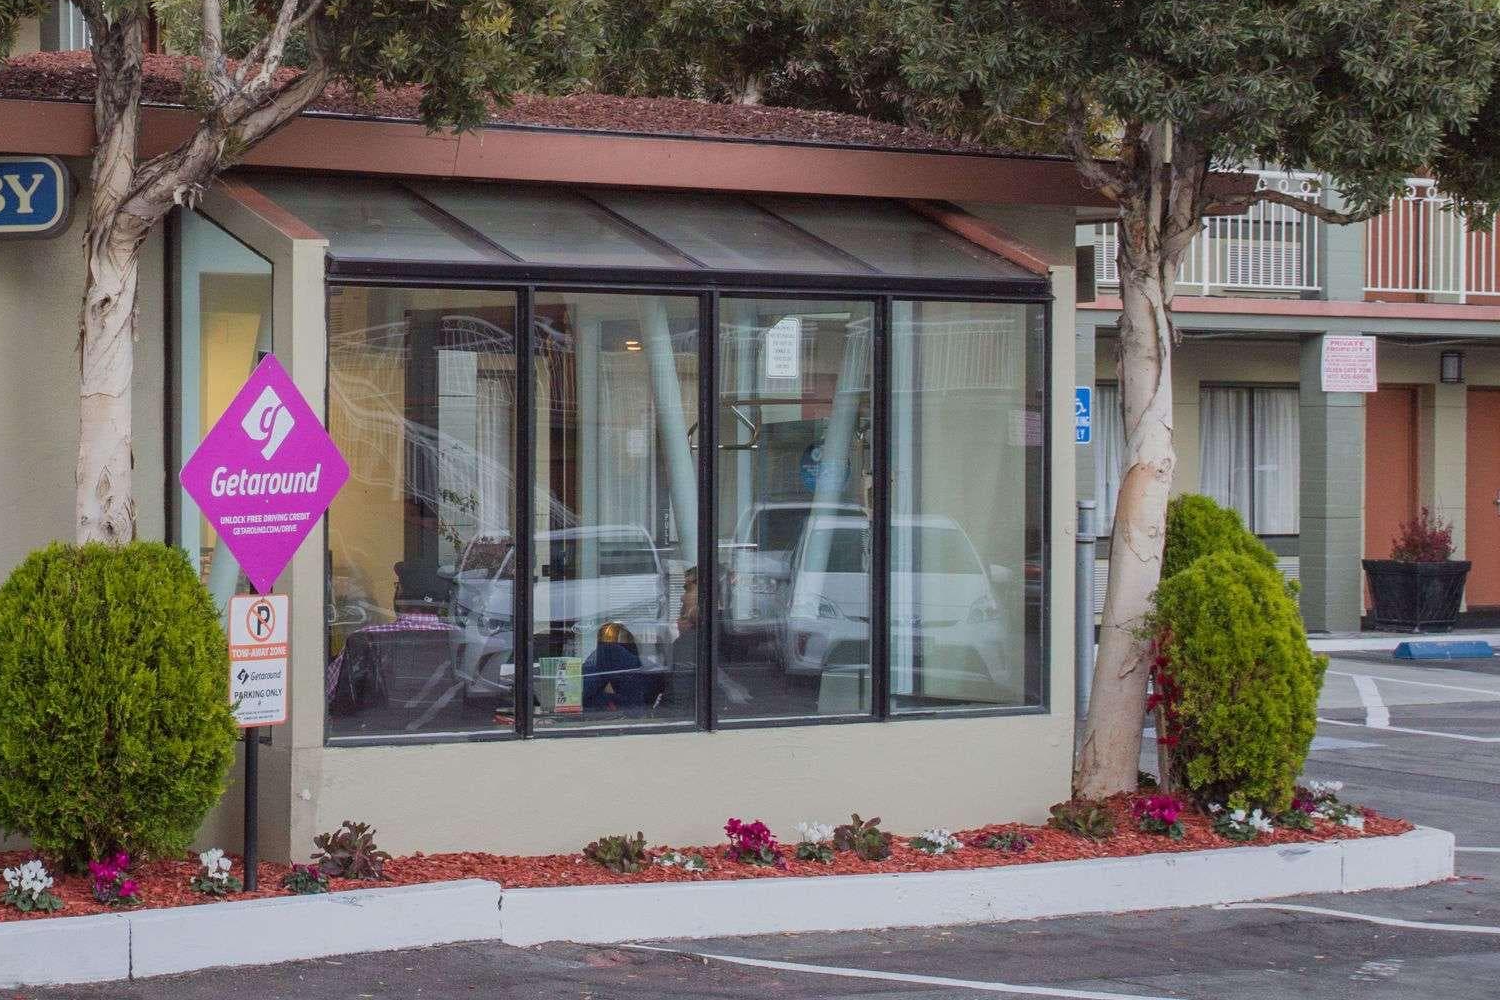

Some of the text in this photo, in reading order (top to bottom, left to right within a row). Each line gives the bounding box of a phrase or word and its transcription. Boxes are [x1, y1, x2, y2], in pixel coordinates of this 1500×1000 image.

[211, 463, 322, 497] Getaround
[220, 512, 310, 524] UNLOCK FREE DRIVING CREDIT
[232, 646, 287, 658] TOW-AWAY ZONE
[250, 670, 282, 681] Getaround
[234, 688, 283, 699] PARKING ONLY
